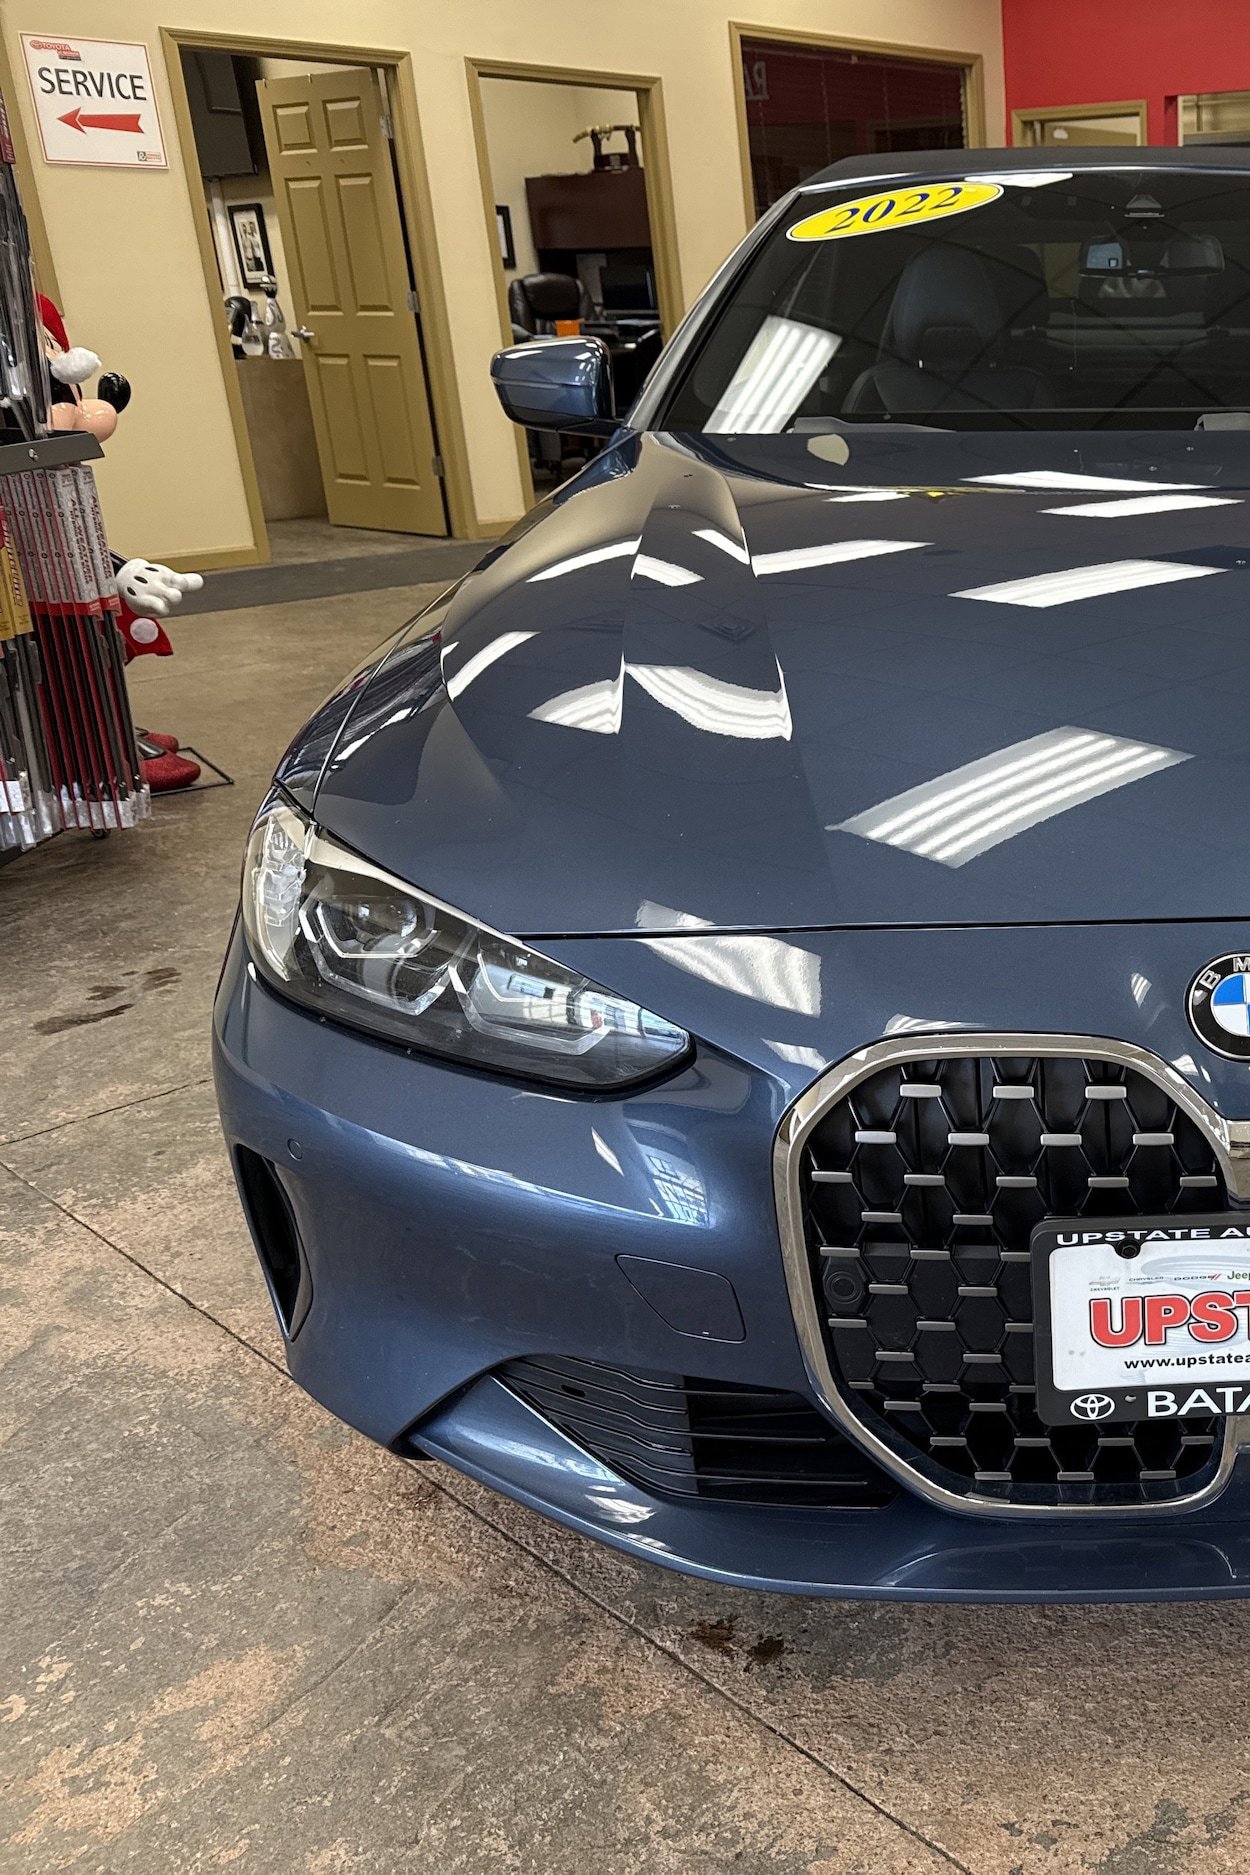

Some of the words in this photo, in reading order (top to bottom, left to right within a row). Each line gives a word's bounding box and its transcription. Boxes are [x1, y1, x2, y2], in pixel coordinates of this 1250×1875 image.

[38, 66, 147, 101] SERVICE
[824, 187, 963, 234] 2022
[1056, 1228, 1211, 1246] UPSTATE
